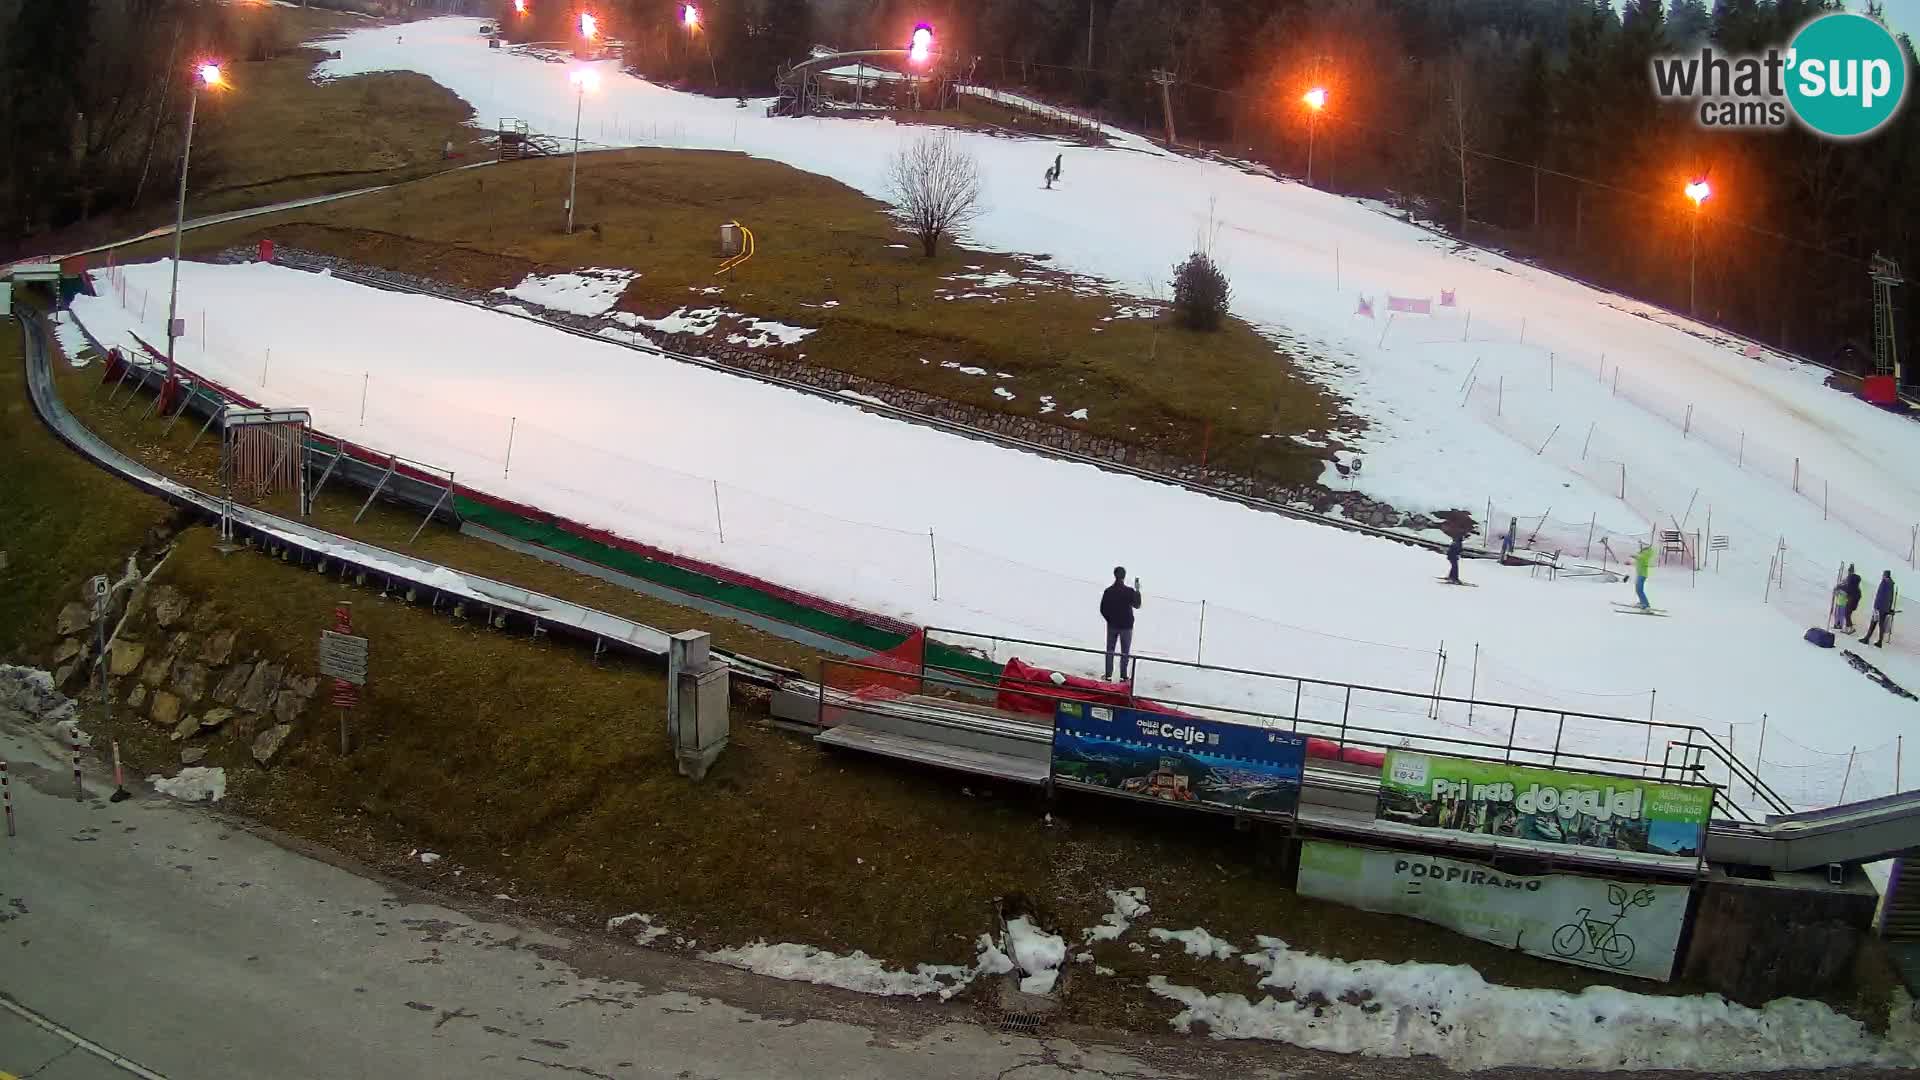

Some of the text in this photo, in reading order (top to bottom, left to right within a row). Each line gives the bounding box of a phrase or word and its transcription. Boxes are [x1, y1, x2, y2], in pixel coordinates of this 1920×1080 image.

[1160, 723, 1206, 745] Celje
[1431, 778, 1468, 801] Pri
[1472, 782, 1514, 802] nas
[1394, 859, 1542, 892] PODPIRAMO
